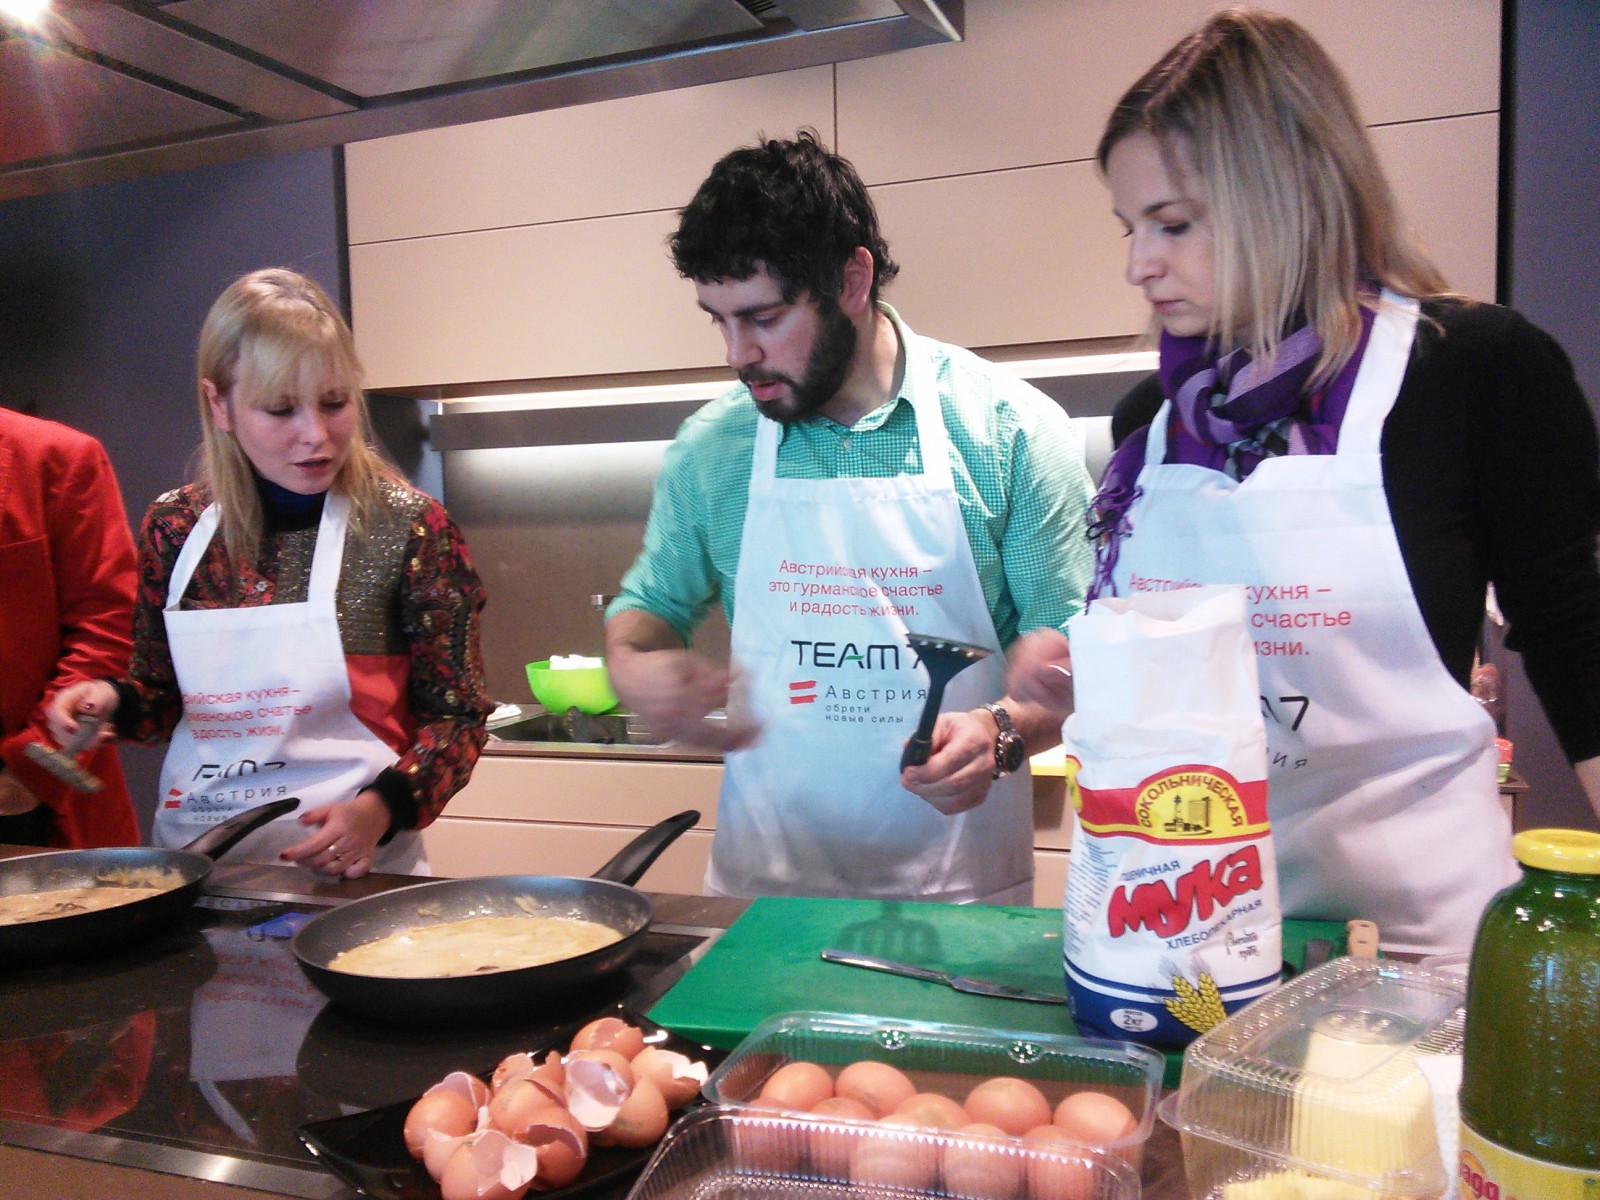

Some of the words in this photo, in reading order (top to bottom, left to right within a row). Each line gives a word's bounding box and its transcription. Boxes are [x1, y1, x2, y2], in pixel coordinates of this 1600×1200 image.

[870, 567, 918, 581] кухня
[769, 581, 790, 593] это
[793, 582, 878, 598] гурмансое
[881, 584, 943, 597] счастье
[789, 601, 797, 612] и
[801, 602, 867, 617] радость
[868, 604, 920, 617] жизни.
[1251, 611, 1352, 628] счастье
[791, 640, 900, 670] TEAM
[825, 685, 927, 703] Австрия
[825, 703, 871, 714] обрети
[825, 715, 864, 723] новые
[871, 716, 904, 724] силы
[187, 786, 288, 804] Австрия
[1138, 775, 1243, 828] СОКОЛЬНИЧЕСКАЯ
